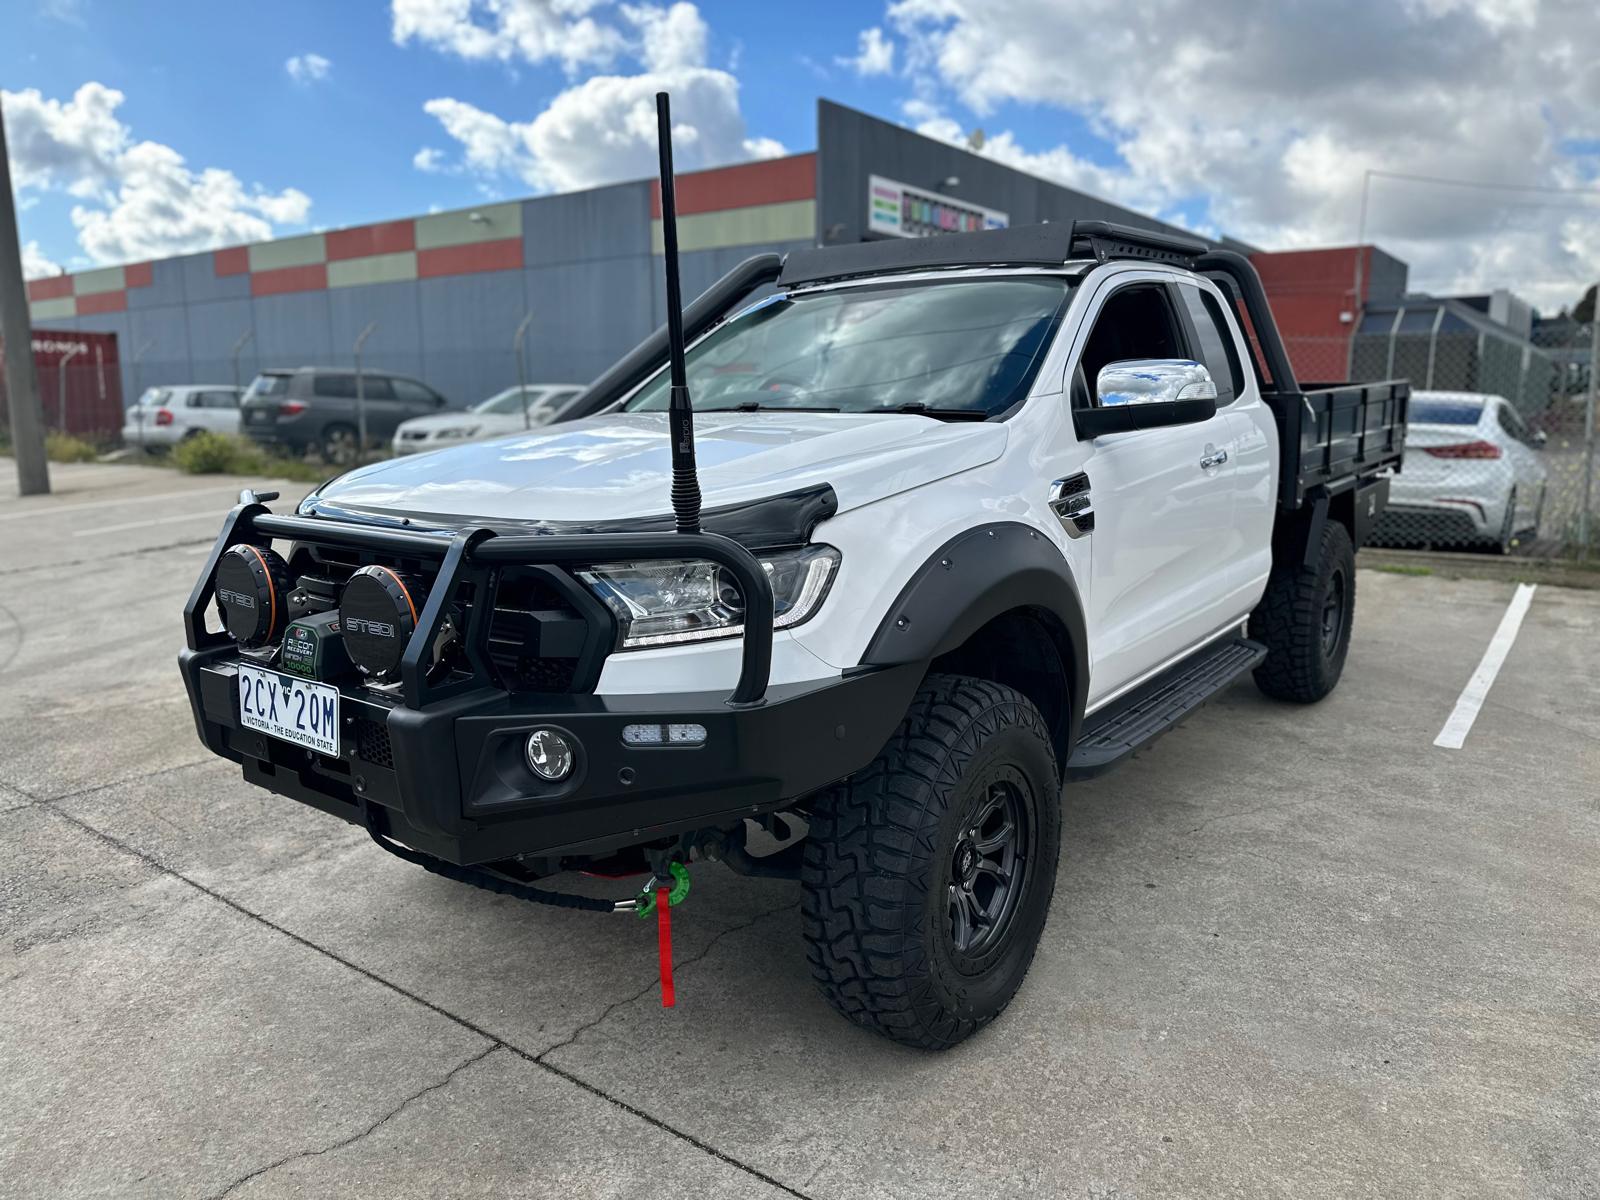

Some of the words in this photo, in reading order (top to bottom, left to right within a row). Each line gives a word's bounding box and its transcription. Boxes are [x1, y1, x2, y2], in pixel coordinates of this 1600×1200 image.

[219, 588, 255, 609] STEDI
[346, 617, 395, 638] STEDI
[287, 661, 312, 673] 10000
[242, 674, 279, 723] 2CX
[281, 685, 292, 695] VIC
[246, 715, 270, 730] VICTORIA
[273, 724, 284, 735] THE
[285, 728, 316, 746] EDUCATION
[316, 738, 333, 751] STATE
